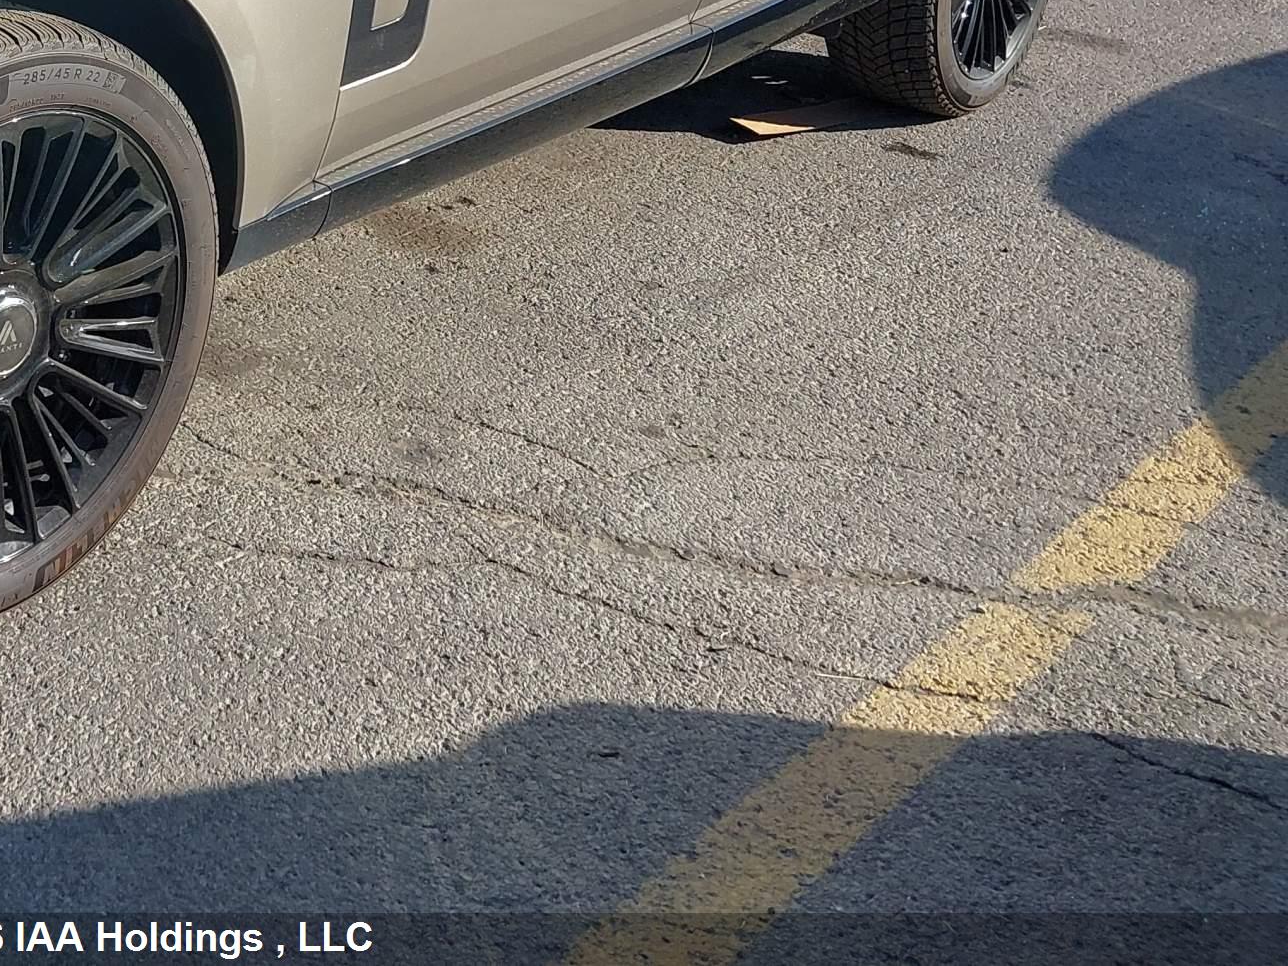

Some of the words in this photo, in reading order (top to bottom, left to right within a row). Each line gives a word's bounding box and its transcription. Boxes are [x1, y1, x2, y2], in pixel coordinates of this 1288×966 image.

[23, 67, 71, 85] 285/45
[73, 68, 82, 80] R
[86, 70, 101, 83] 22
